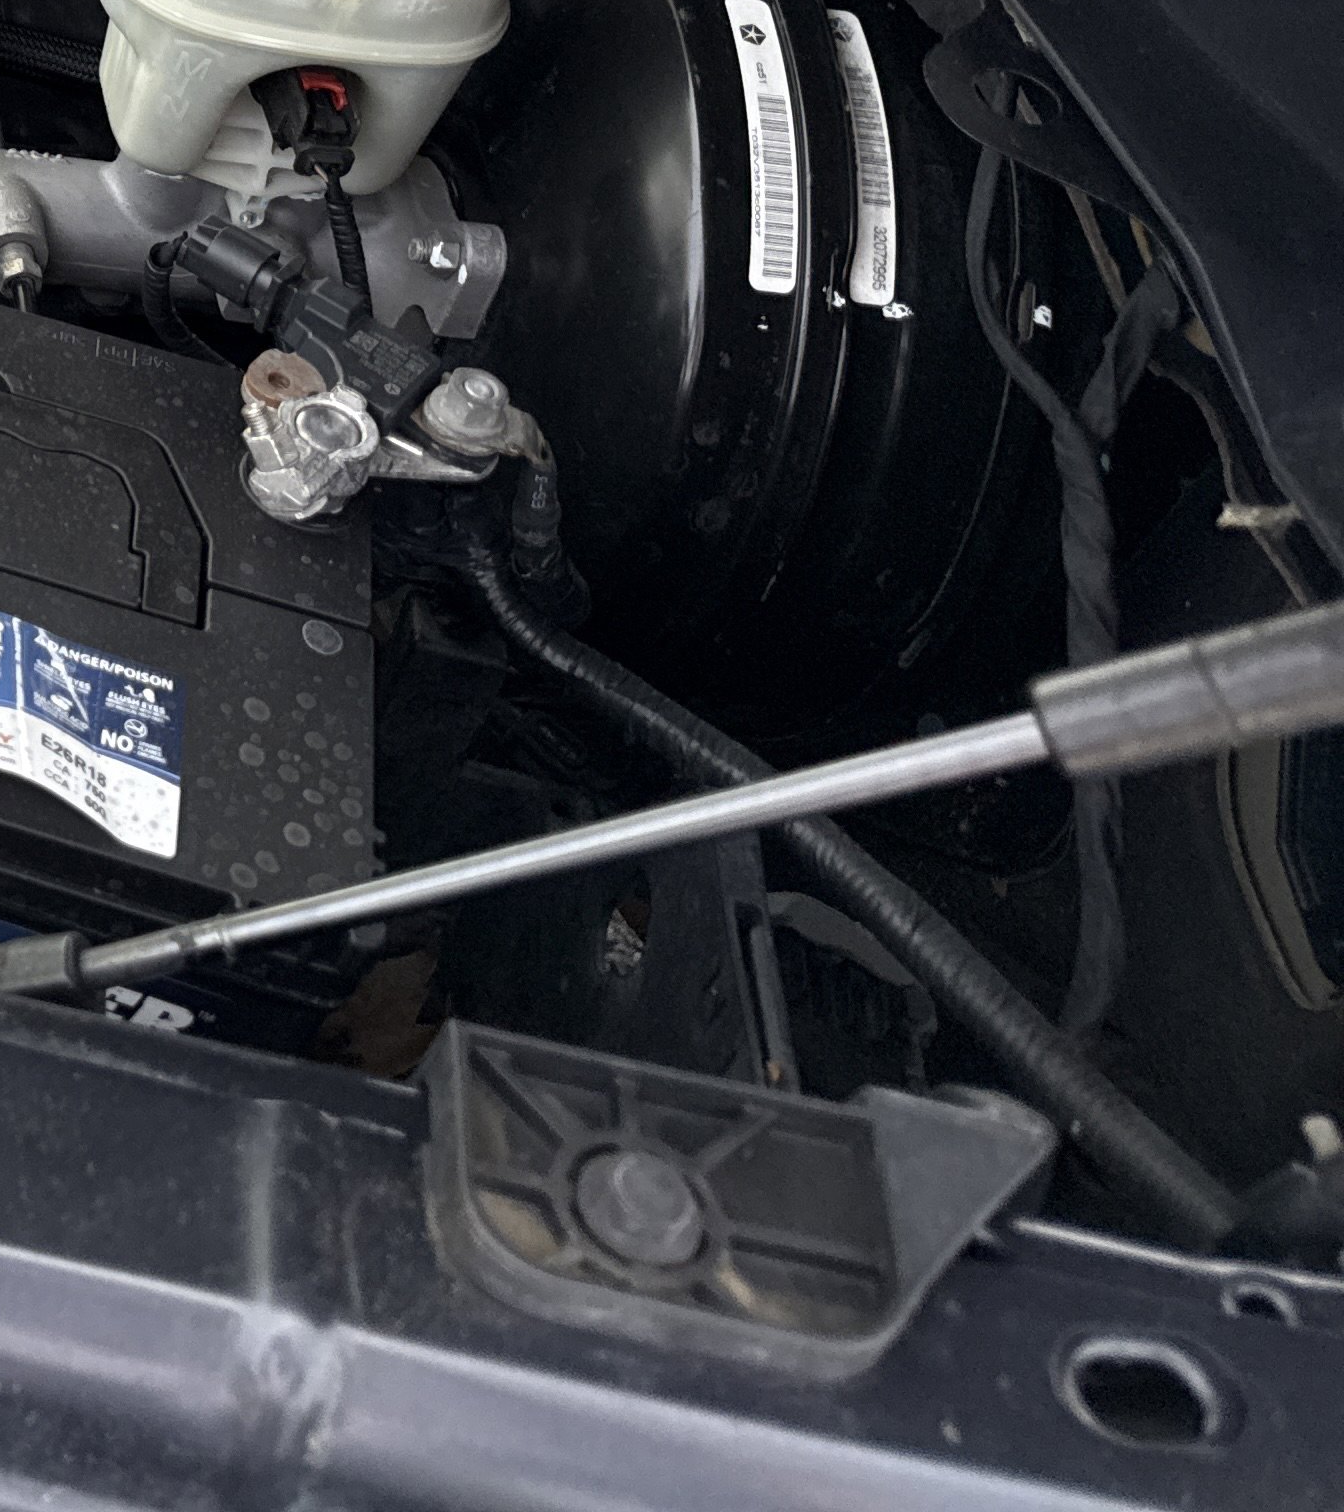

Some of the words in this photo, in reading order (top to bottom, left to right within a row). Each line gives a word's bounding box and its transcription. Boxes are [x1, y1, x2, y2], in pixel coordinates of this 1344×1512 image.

[47, 640, 174, 691] DANGER/POISON
[100, 728, 134, 753] NO
[40, 732, 107, 788] E26R18
[44, 768, 71, 791] CCA
